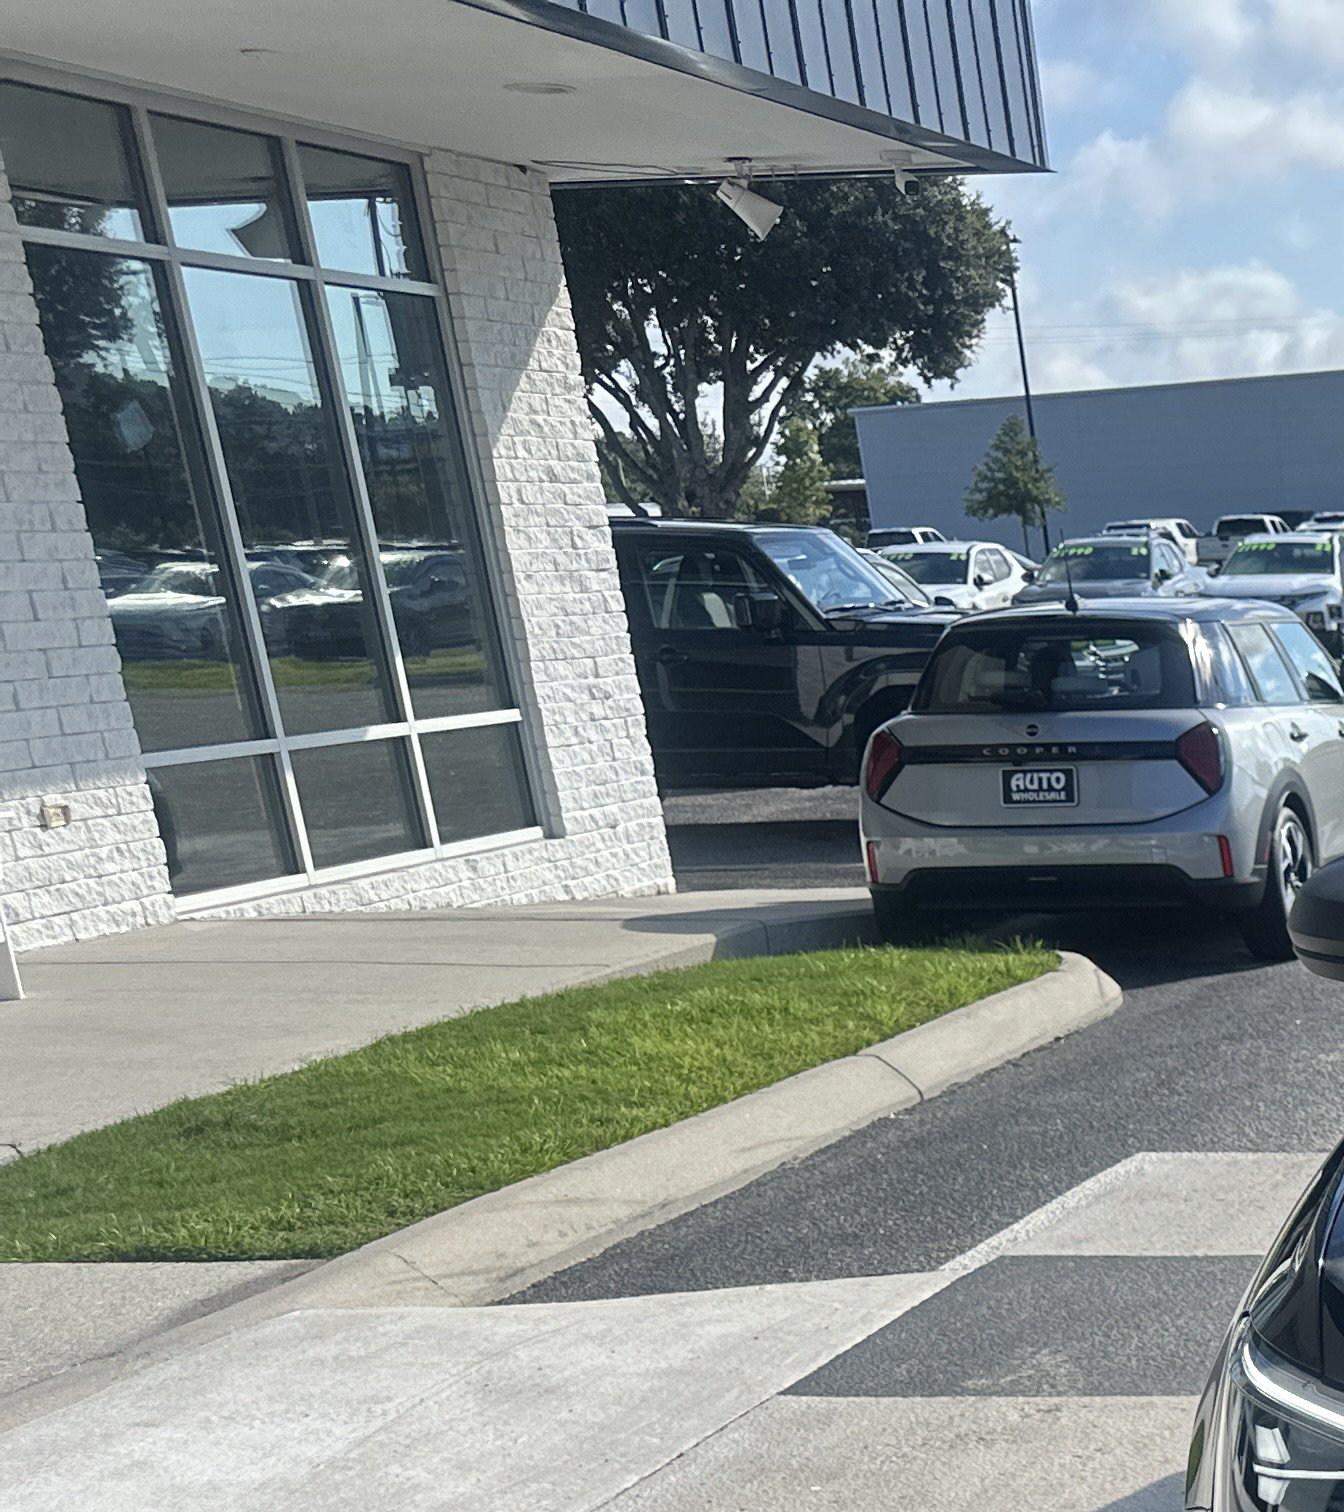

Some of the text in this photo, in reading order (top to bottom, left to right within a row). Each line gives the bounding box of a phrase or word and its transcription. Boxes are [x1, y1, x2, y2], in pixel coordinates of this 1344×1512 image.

[982, 746, 1077, 756] COOPER
[1010, 772, 1066, 791] AUTO
[1011, 791, 1066, 801] WHOLESALE
